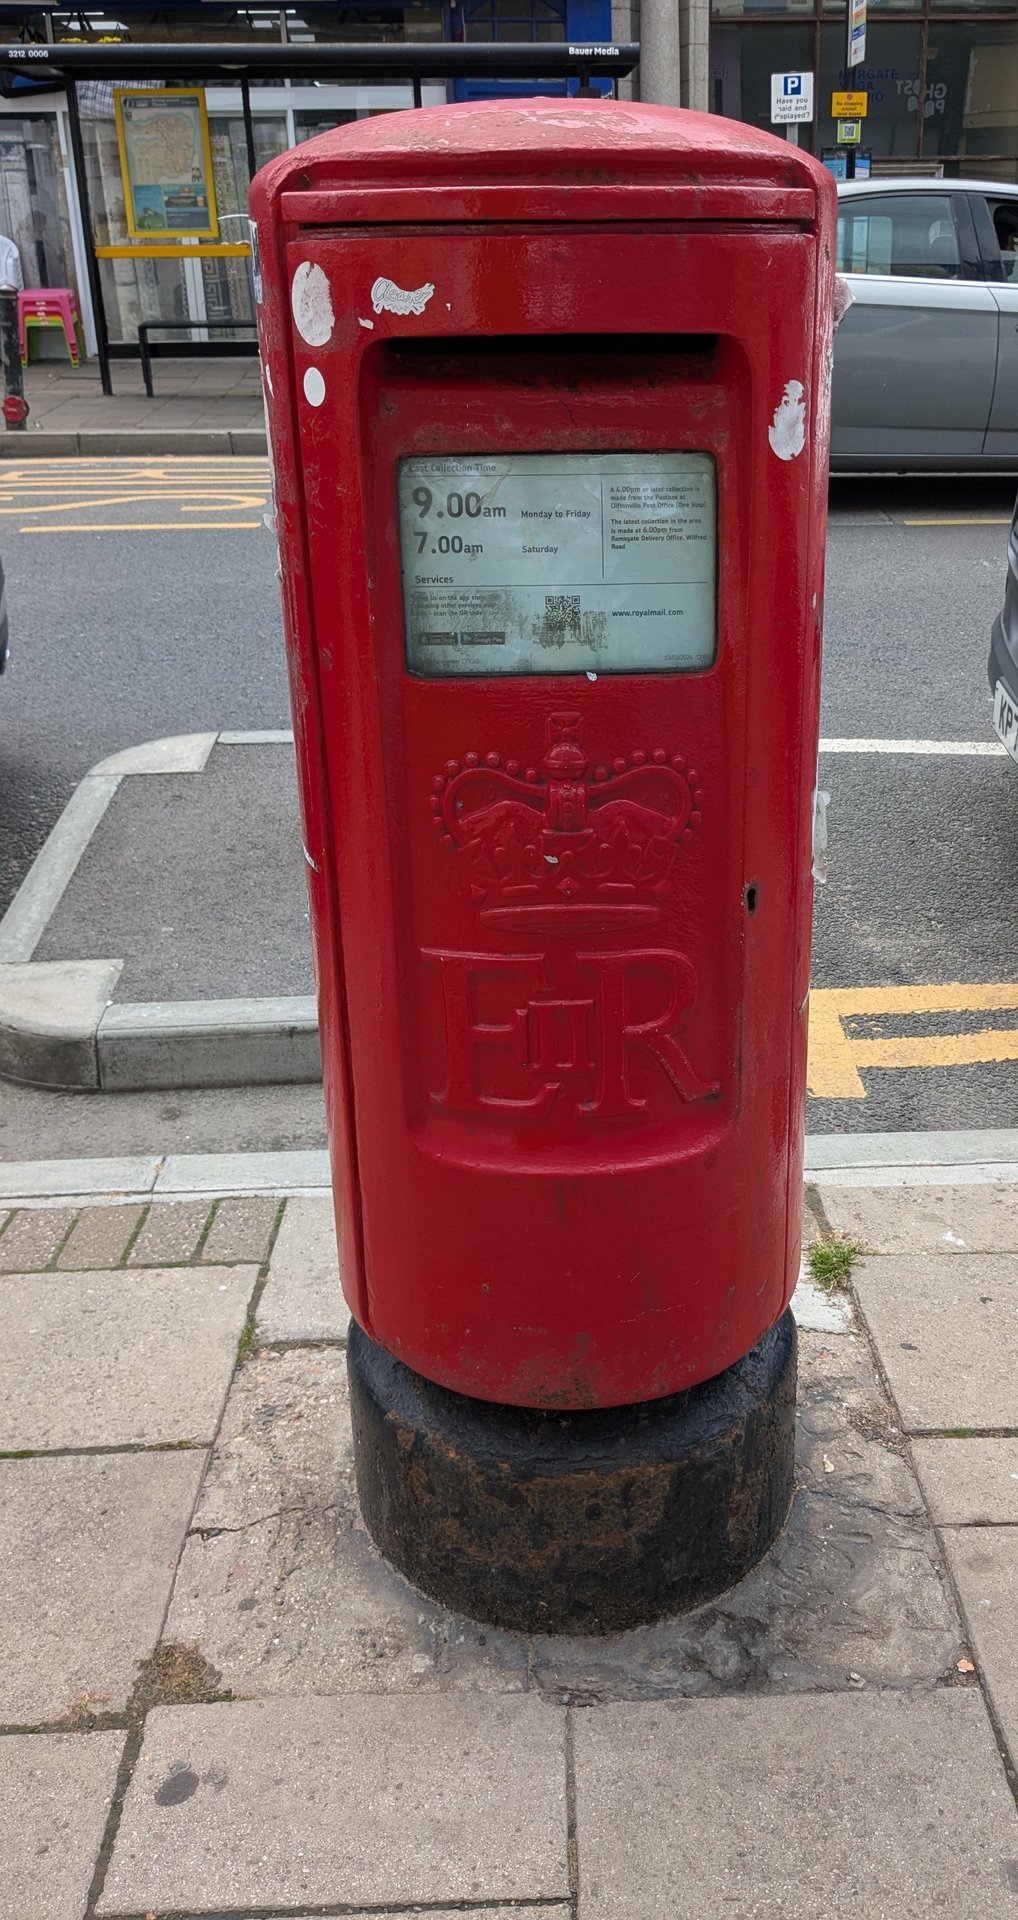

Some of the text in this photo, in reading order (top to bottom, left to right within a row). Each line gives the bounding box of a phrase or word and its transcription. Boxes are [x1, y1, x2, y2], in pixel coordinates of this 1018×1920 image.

[8, 49, 49, 58] 3212 0006
[569, 47, 620, 56] Bauer Media
[838, 69, 898, 80] MRGATE
[788, 78, 799, 95] P
[774, 111, 810, 120] splayed?
[409, 463, 496, 472] Last Collection Time
[412, 486, 507, 518] 9.00am
[521, 509, 591, 519] Monday to Friday
[643, 526, 668, 534] 6.00pm
[412, 531, 559, 554] 7.00am Saturday
[414, 575, 454, 584] Services
[611, 607, 684, 618] www.royalmail.com
[473, 636, 503, 644] Google Play
